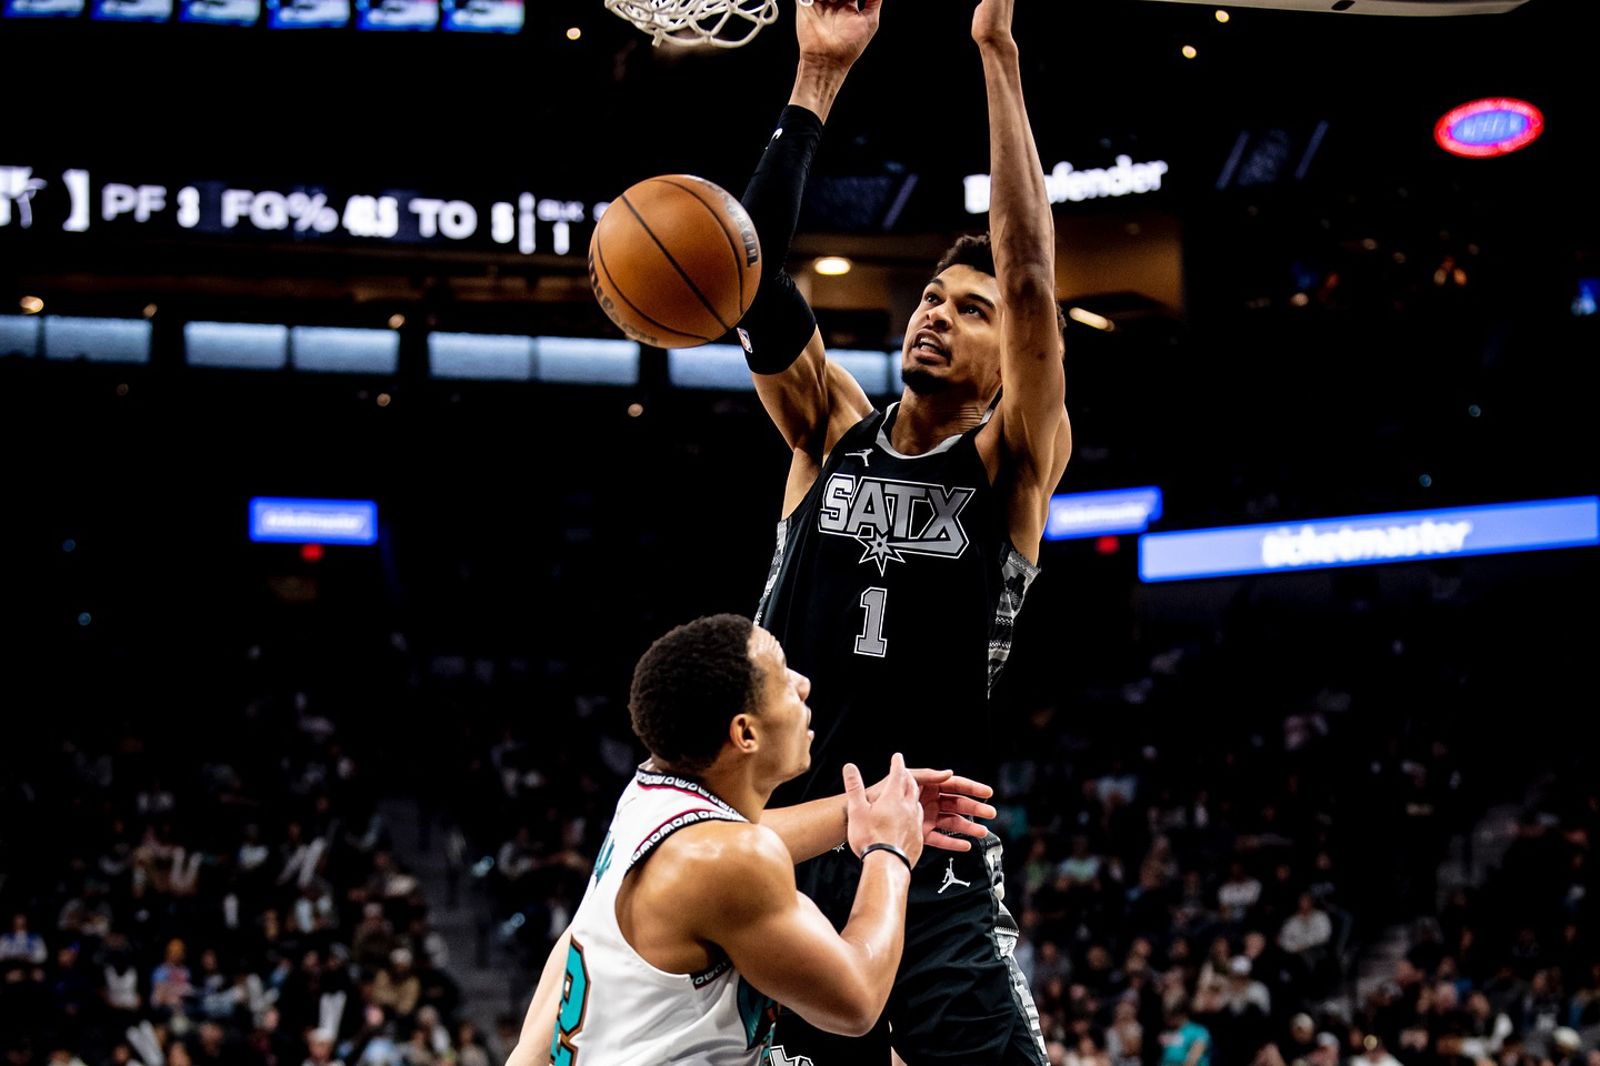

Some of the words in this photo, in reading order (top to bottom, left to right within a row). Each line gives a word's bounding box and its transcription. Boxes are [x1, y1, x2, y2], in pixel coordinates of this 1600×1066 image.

[102, 183, 167, 222] PF
[409, 198, 478, 239] TO
[818, 473, 976, 560] SATX
[854, 586, 888, 658] 1
